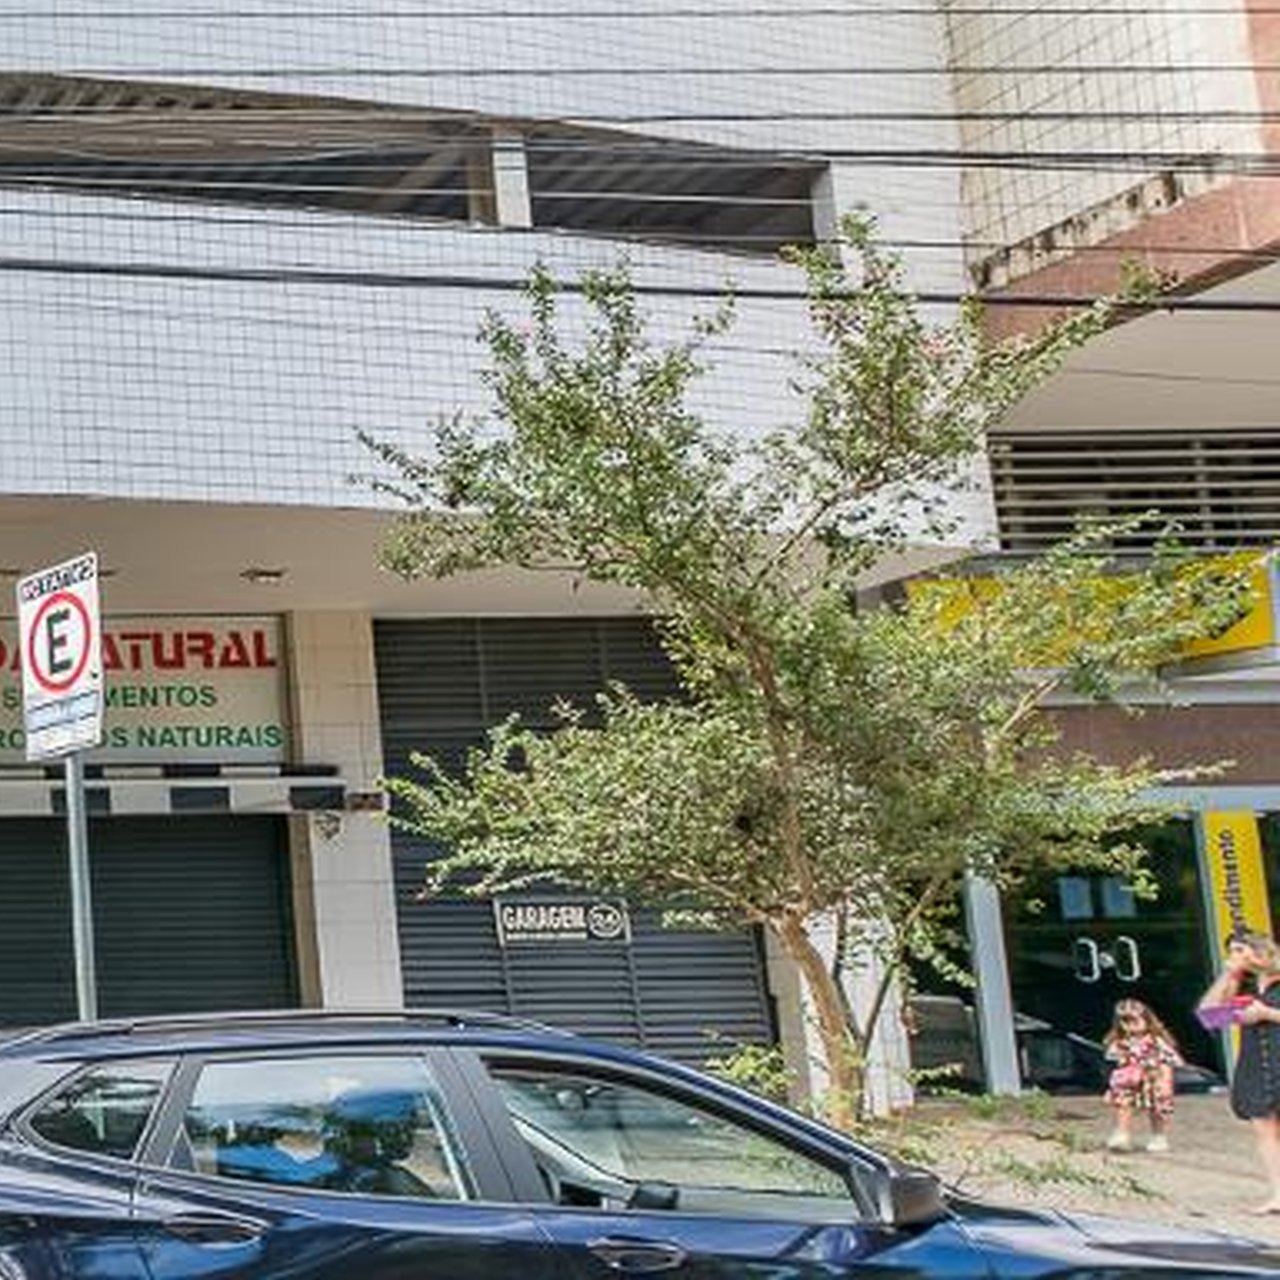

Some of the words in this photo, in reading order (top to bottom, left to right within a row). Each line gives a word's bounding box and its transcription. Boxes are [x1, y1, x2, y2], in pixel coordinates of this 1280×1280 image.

[47, 607, 73, 675] E
[102, 631, 277, 670] ATURAL
[138, 726, 283, 748] NATURAIS
